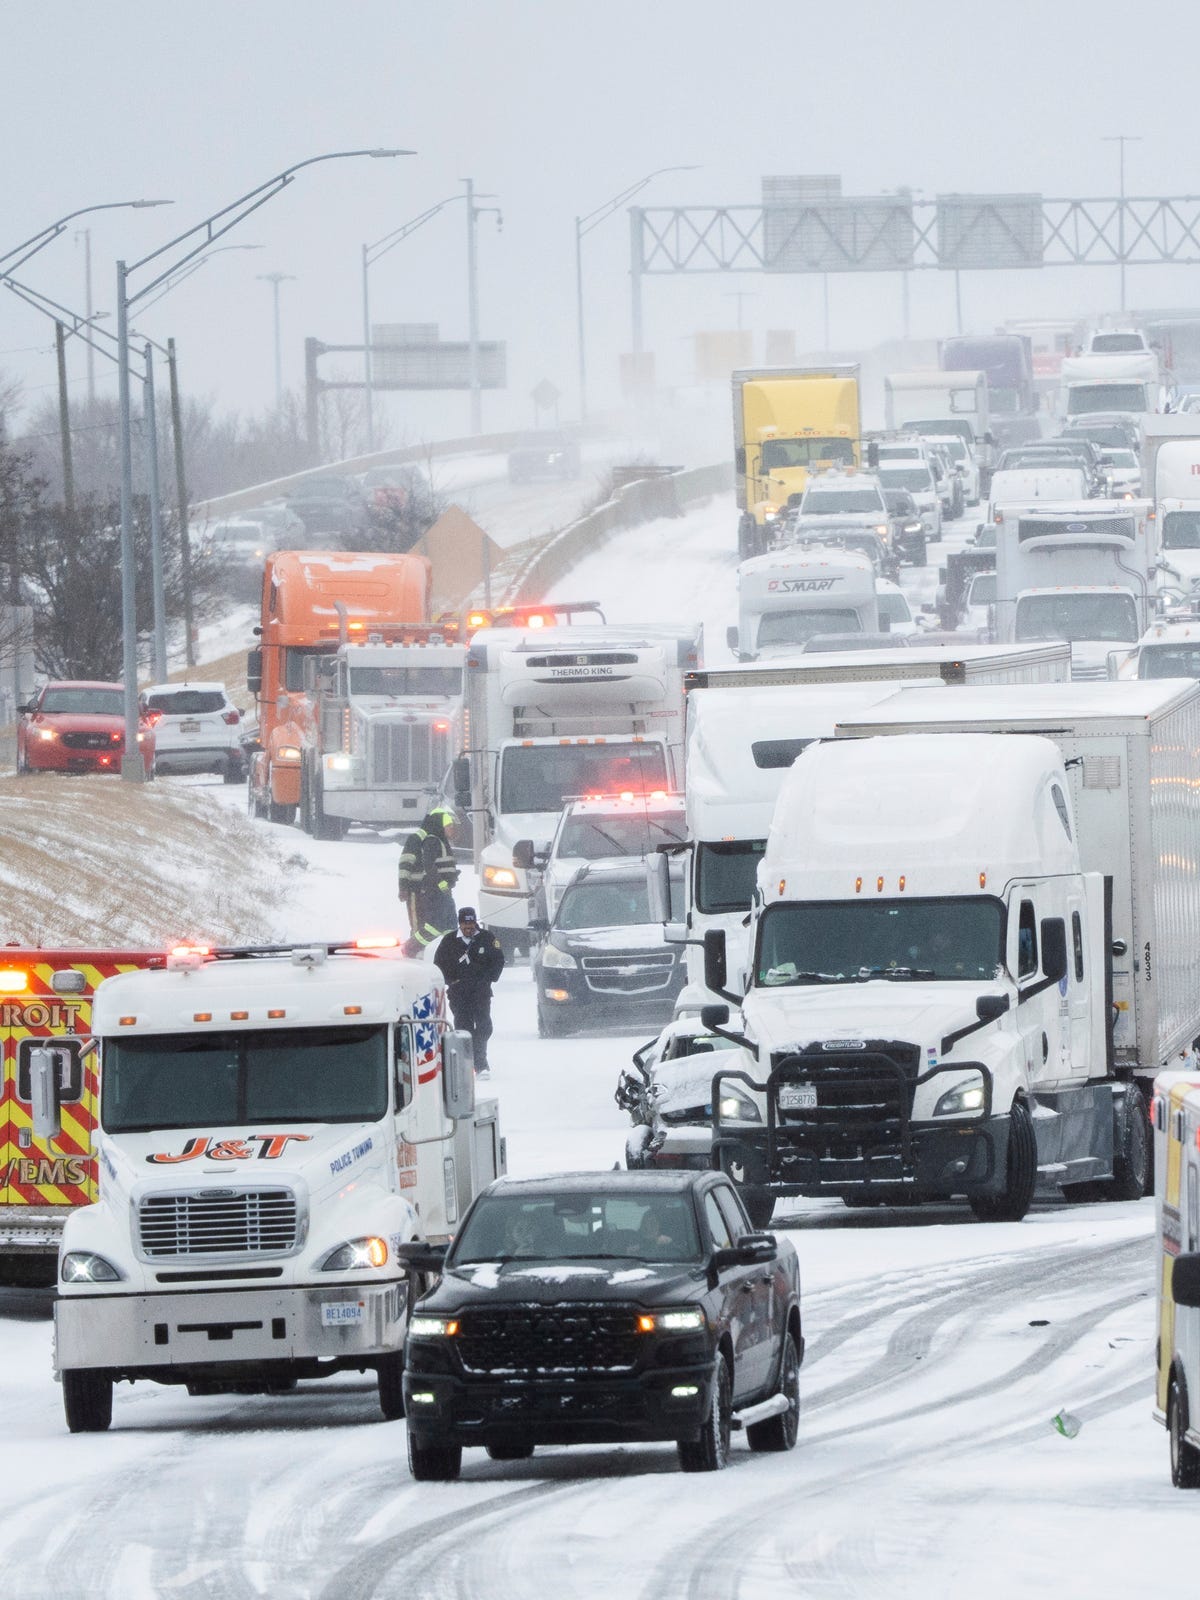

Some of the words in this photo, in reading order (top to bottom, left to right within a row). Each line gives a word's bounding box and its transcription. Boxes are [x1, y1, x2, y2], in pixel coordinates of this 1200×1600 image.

[777, 577, 845, 592] SMART
[551, 668, 590, 676] THERMO
[591, 667, 613, 675] KING
[145, 1133, 313, 1164] J&T
[329, 1151, 352, 1175] POLICE
[352, 1137, 373, 1161] TOWING
